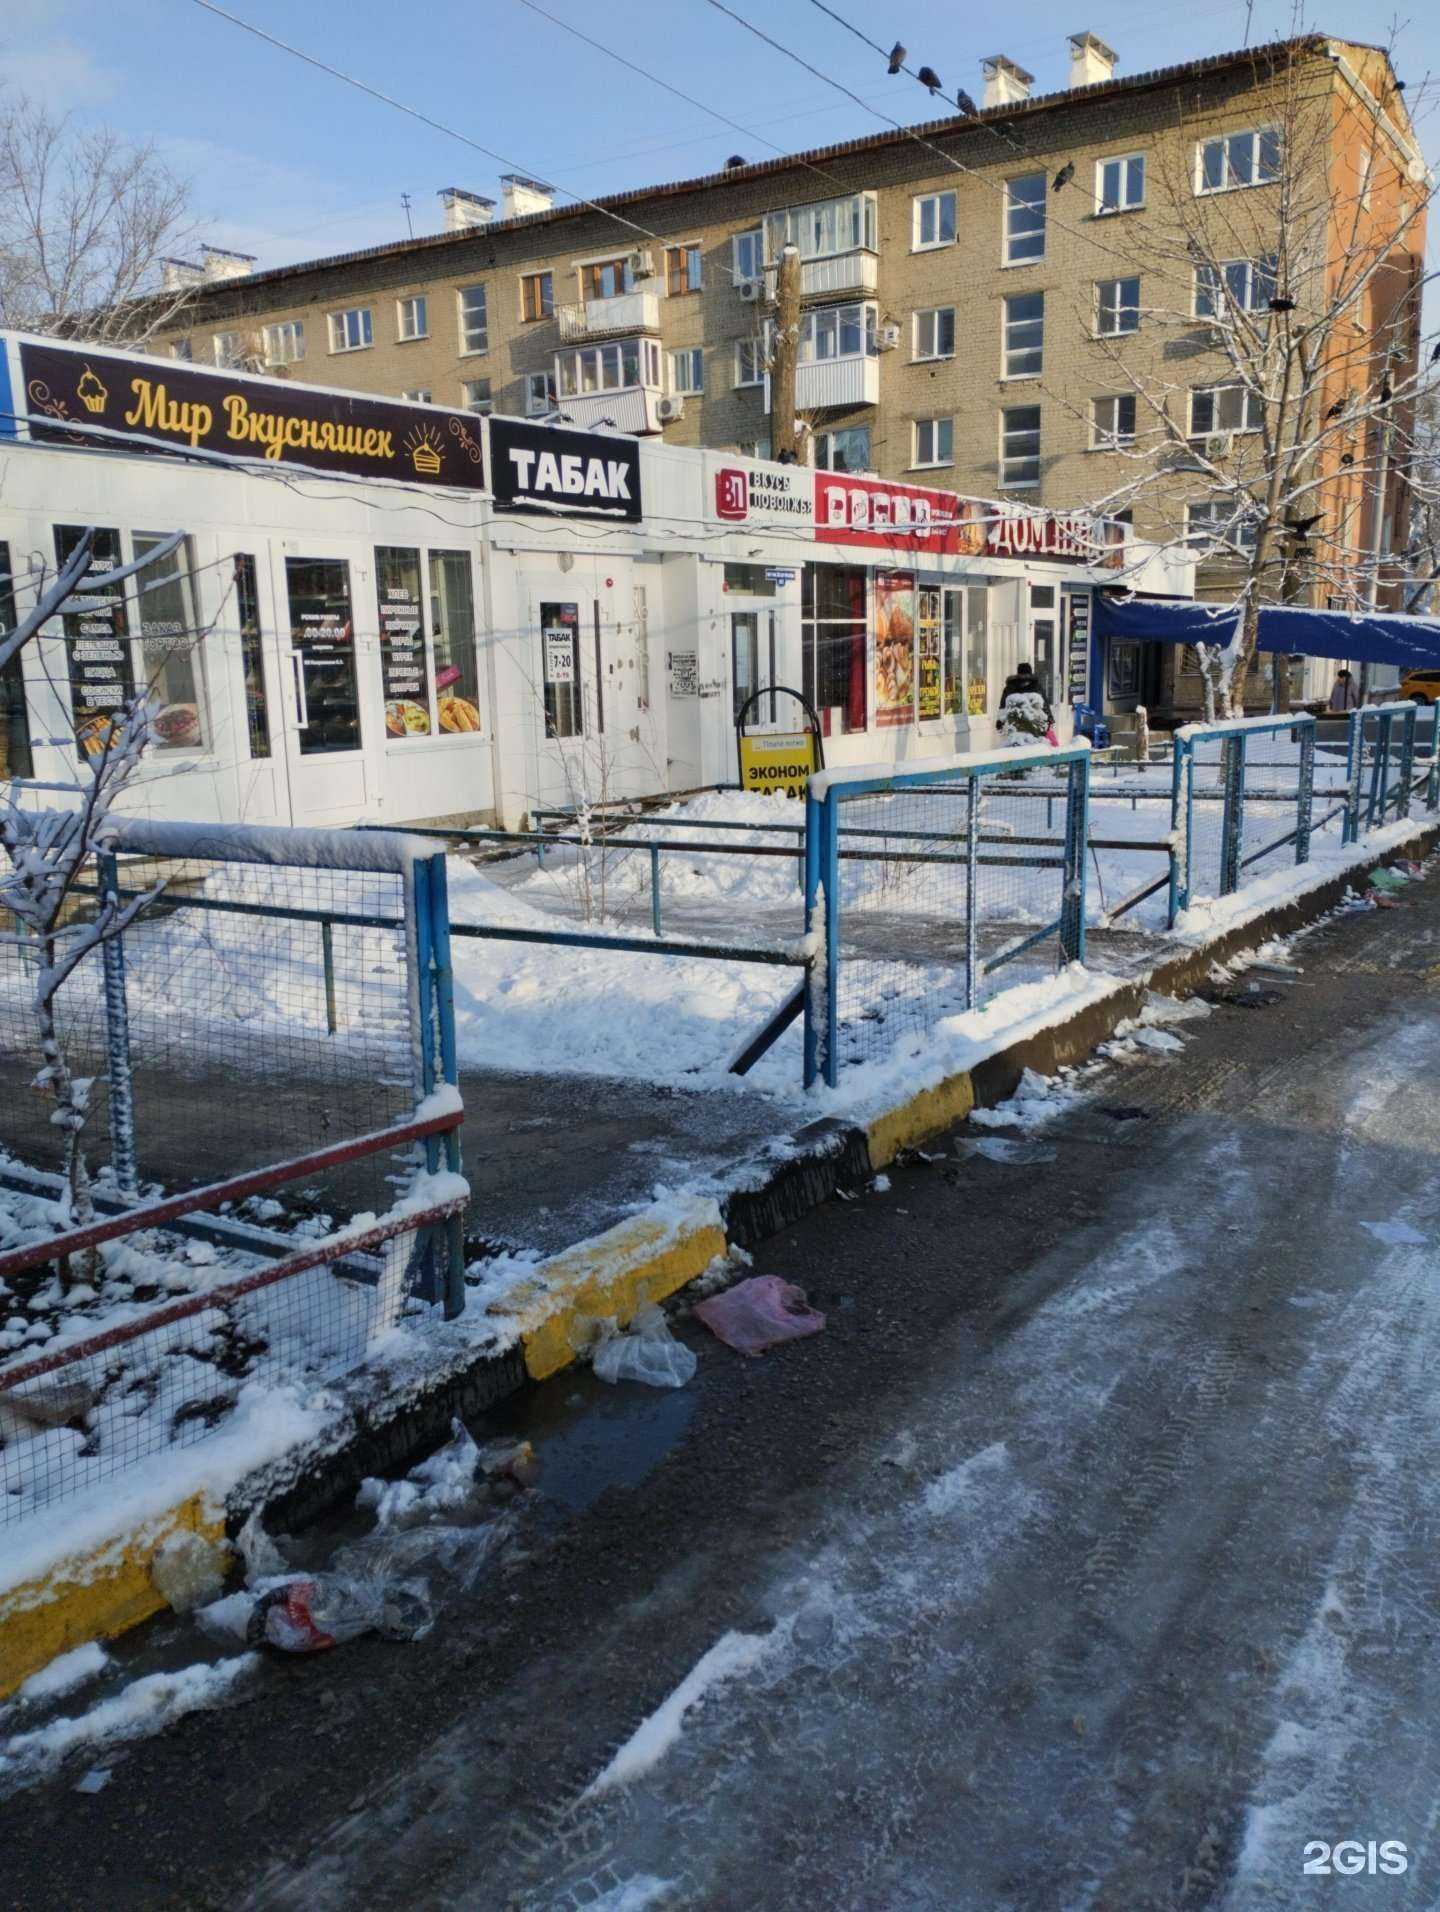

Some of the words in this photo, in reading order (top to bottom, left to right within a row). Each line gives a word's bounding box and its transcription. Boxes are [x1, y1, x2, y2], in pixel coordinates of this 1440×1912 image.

[125, 378, 212, 448] Мир
[222, 393, 396, 460] Вкусняшек
[508, 447, 632, 500] ТАБАК
[750, 493, 812, 514] ПОВОЛЖЬЯ
[547, 633, 571, 642] ТАБАК
[748, 764, 810, 780] ЭКОНОМ
